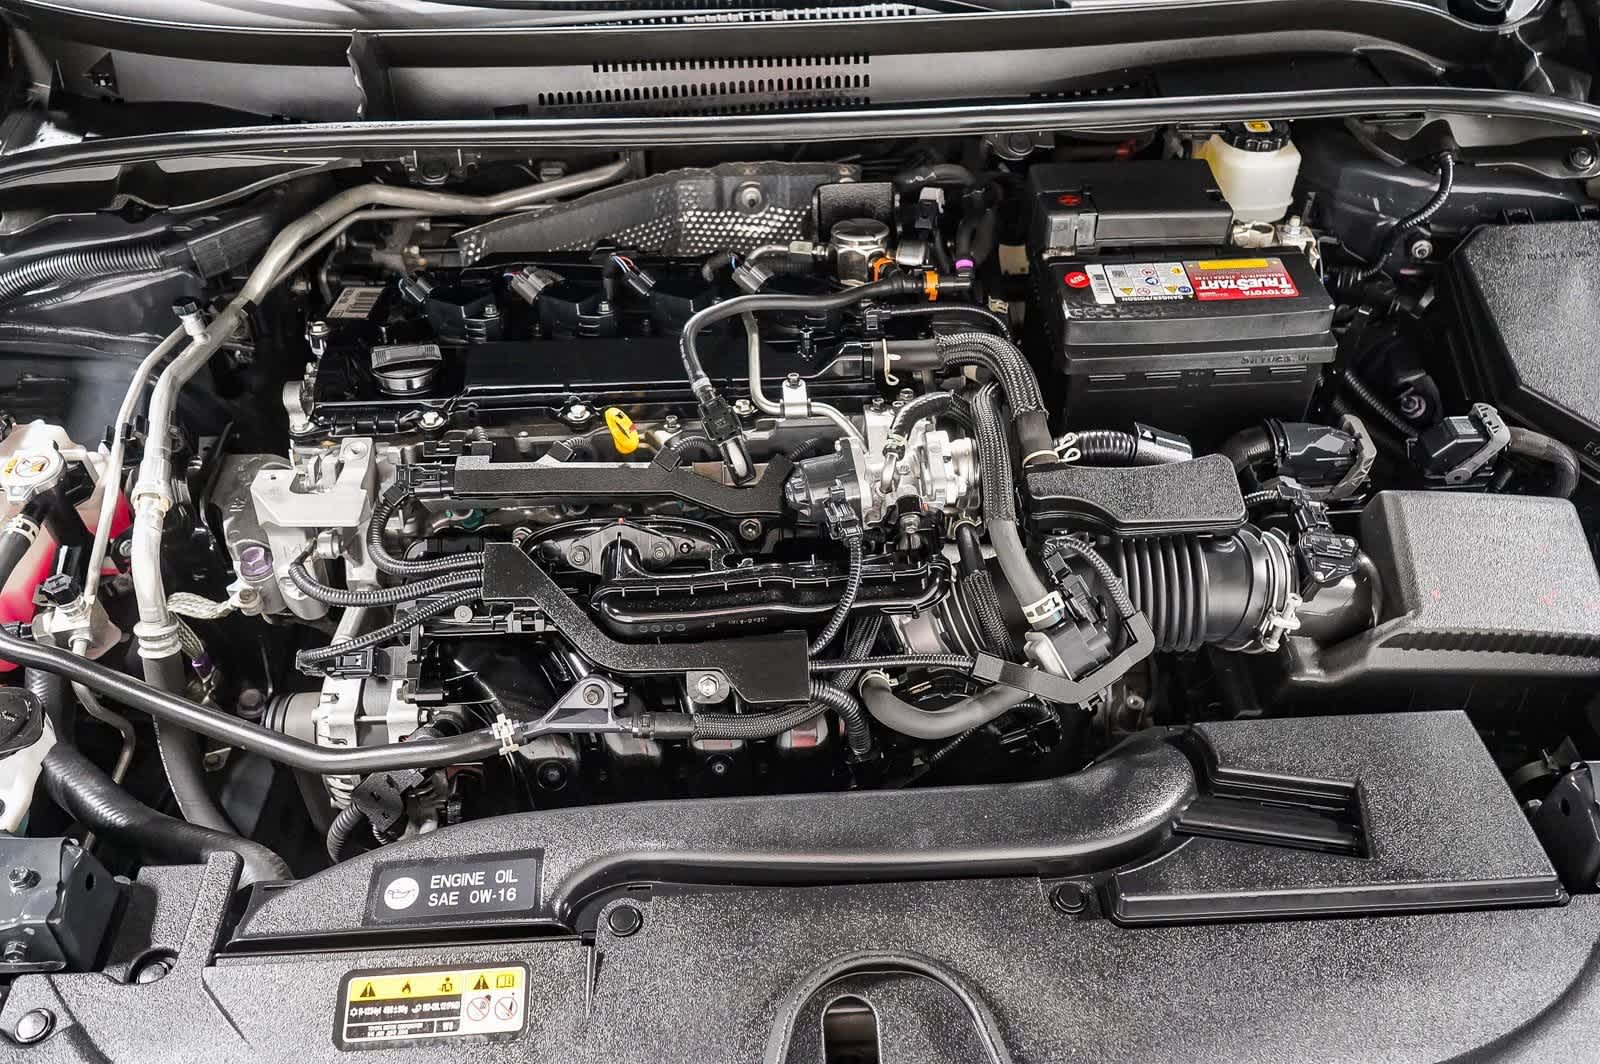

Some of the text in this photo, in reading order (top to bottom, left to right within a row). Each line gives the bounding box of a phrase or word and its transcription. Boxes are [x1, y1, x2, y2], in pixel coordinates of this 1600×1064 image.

[430, 869, 519, 889] ENGINE OIL
[428, 887, 517, 907] SAE 0W-16
